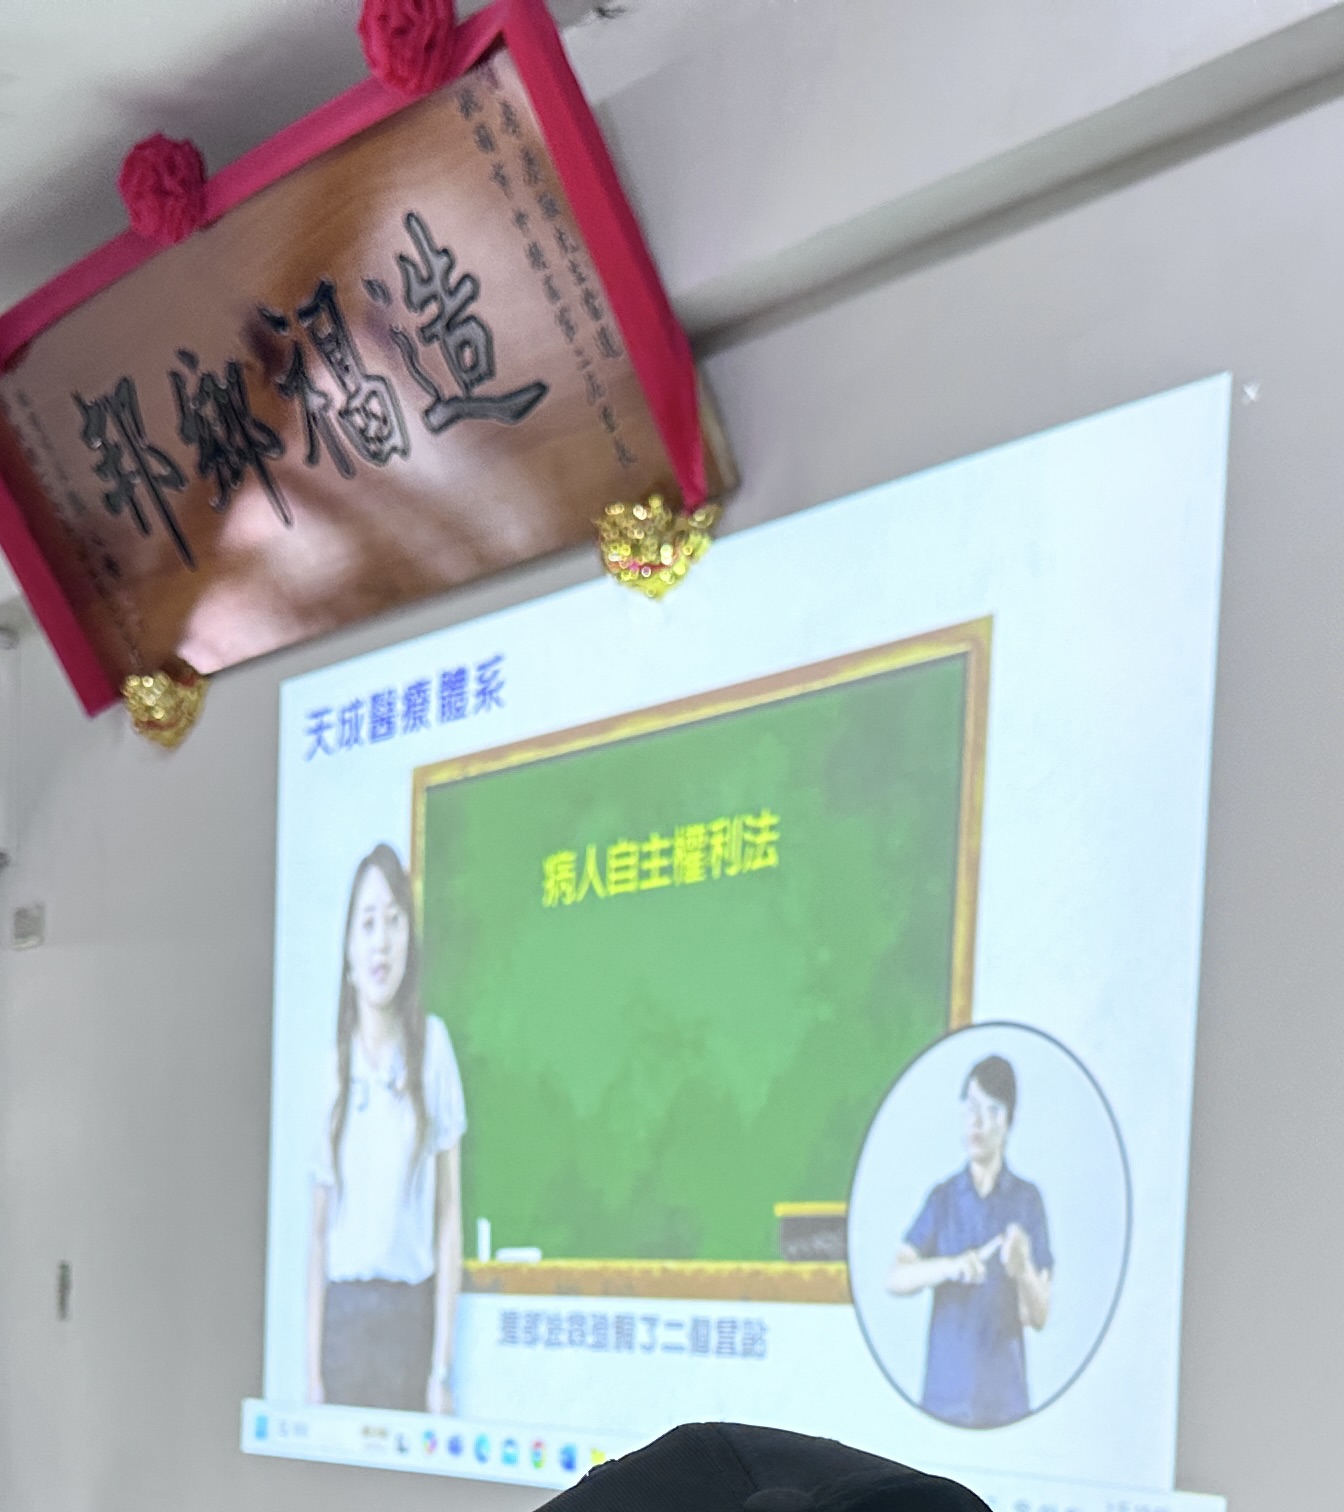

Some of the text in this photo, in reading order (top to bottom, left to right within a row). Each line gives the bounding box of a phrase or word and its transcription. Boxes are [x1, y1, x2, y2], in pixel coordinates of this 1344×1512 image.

[305, 654, 505, 761] 天成醫療體系
[542, 808, 780, 907] 病人自主權利法
